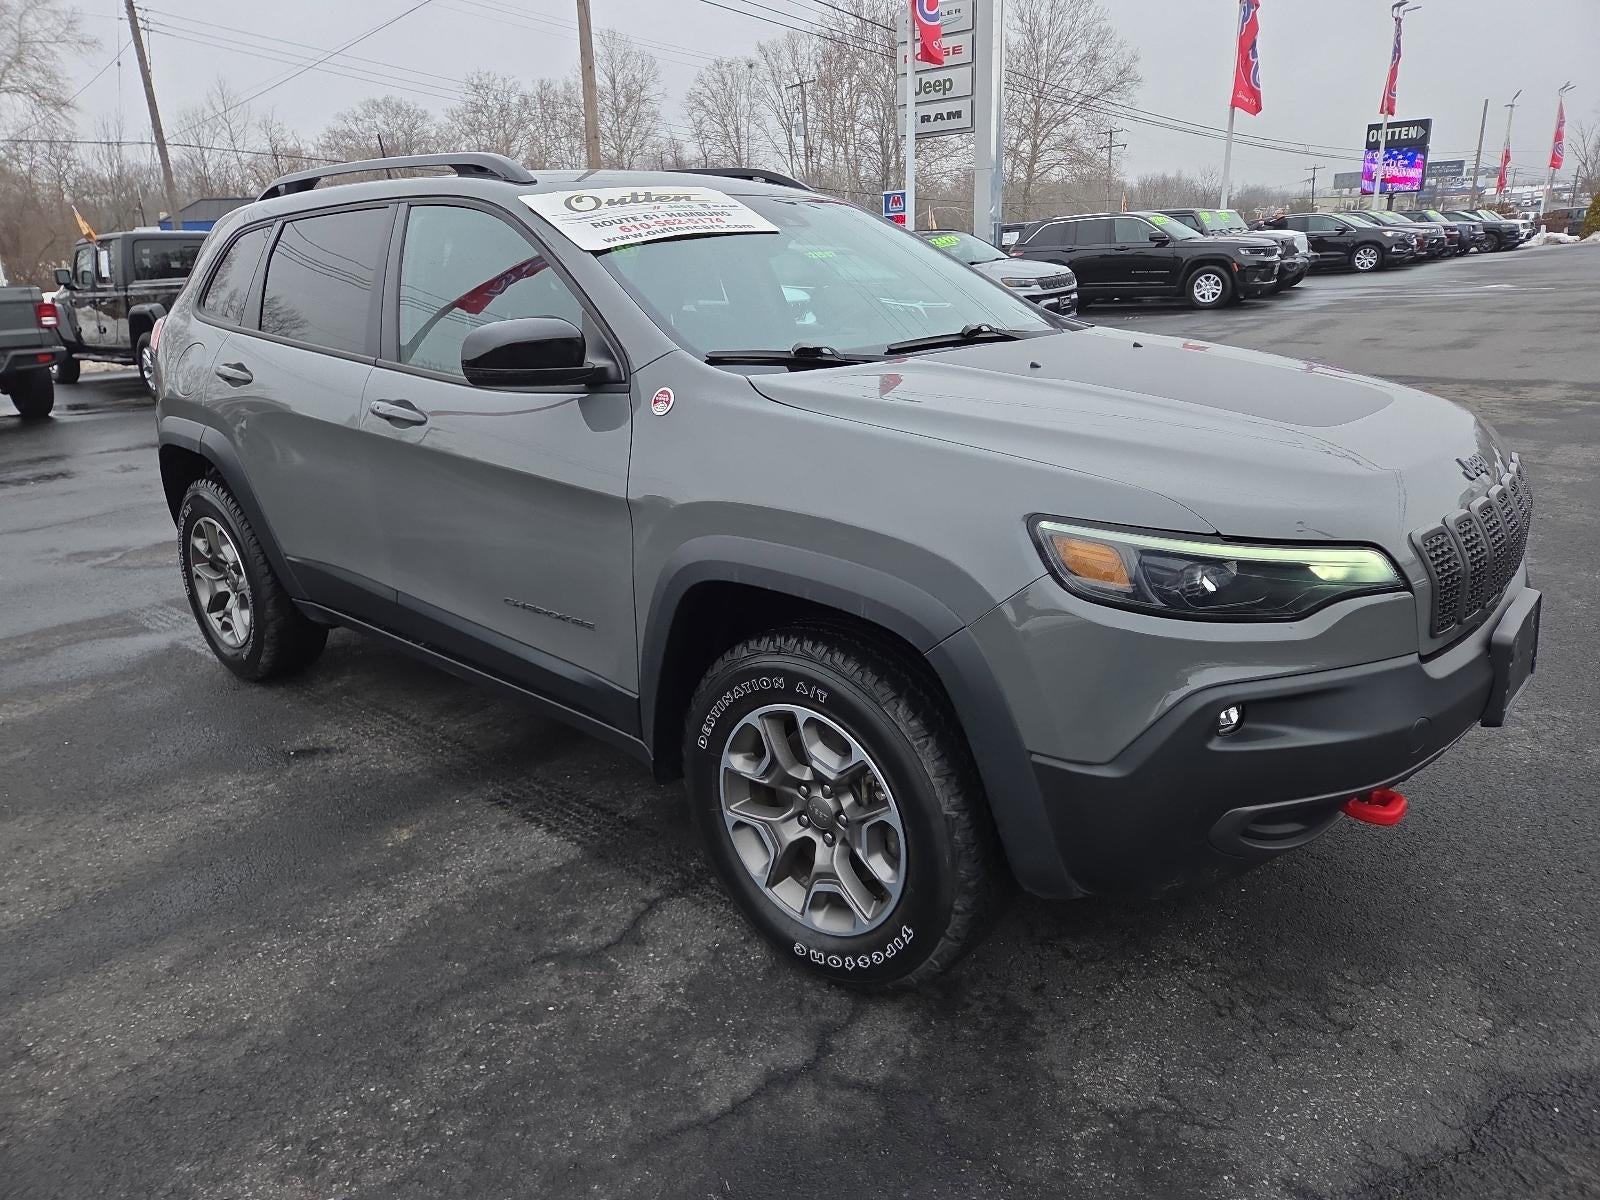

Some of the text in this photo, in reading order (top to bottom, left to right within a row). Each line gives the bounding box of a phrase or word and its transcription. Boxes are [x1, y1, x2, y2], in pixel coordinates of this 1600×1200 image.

[915, 77, 953, 96] Jeep
[920, 110, 962, 123] RAM
[563, 191, 692, 213] Outten
[590, 215, 640, 229] ROUTE
[697, 676, 828, 750] DESTINATION A/T
